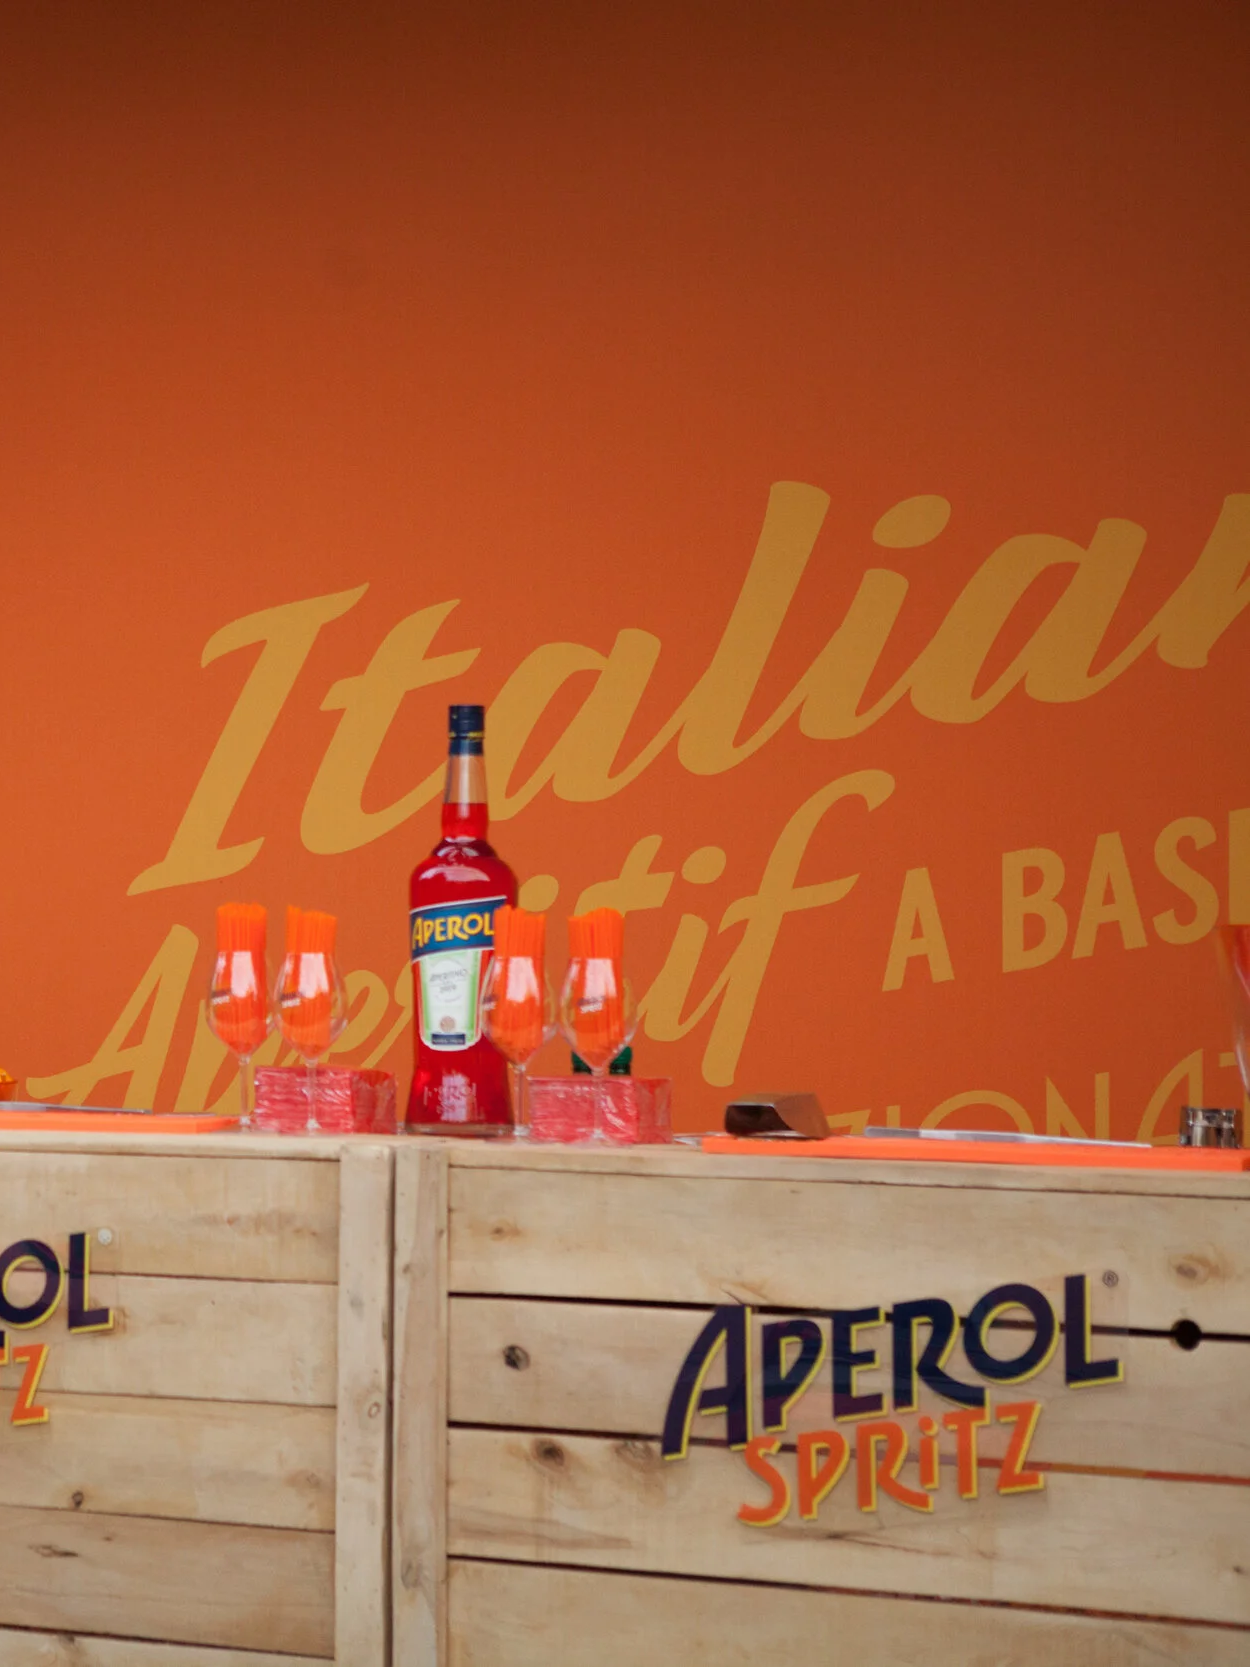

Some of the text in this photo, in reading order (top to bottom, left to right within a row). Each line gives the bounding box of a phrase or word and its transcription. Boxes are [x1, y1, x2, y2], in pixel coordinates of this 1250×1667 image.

[412, 911, 496, 950] APEROL
[881, 866, 956, 992] A
[662, 1274, 1124, 1460] APEROL
